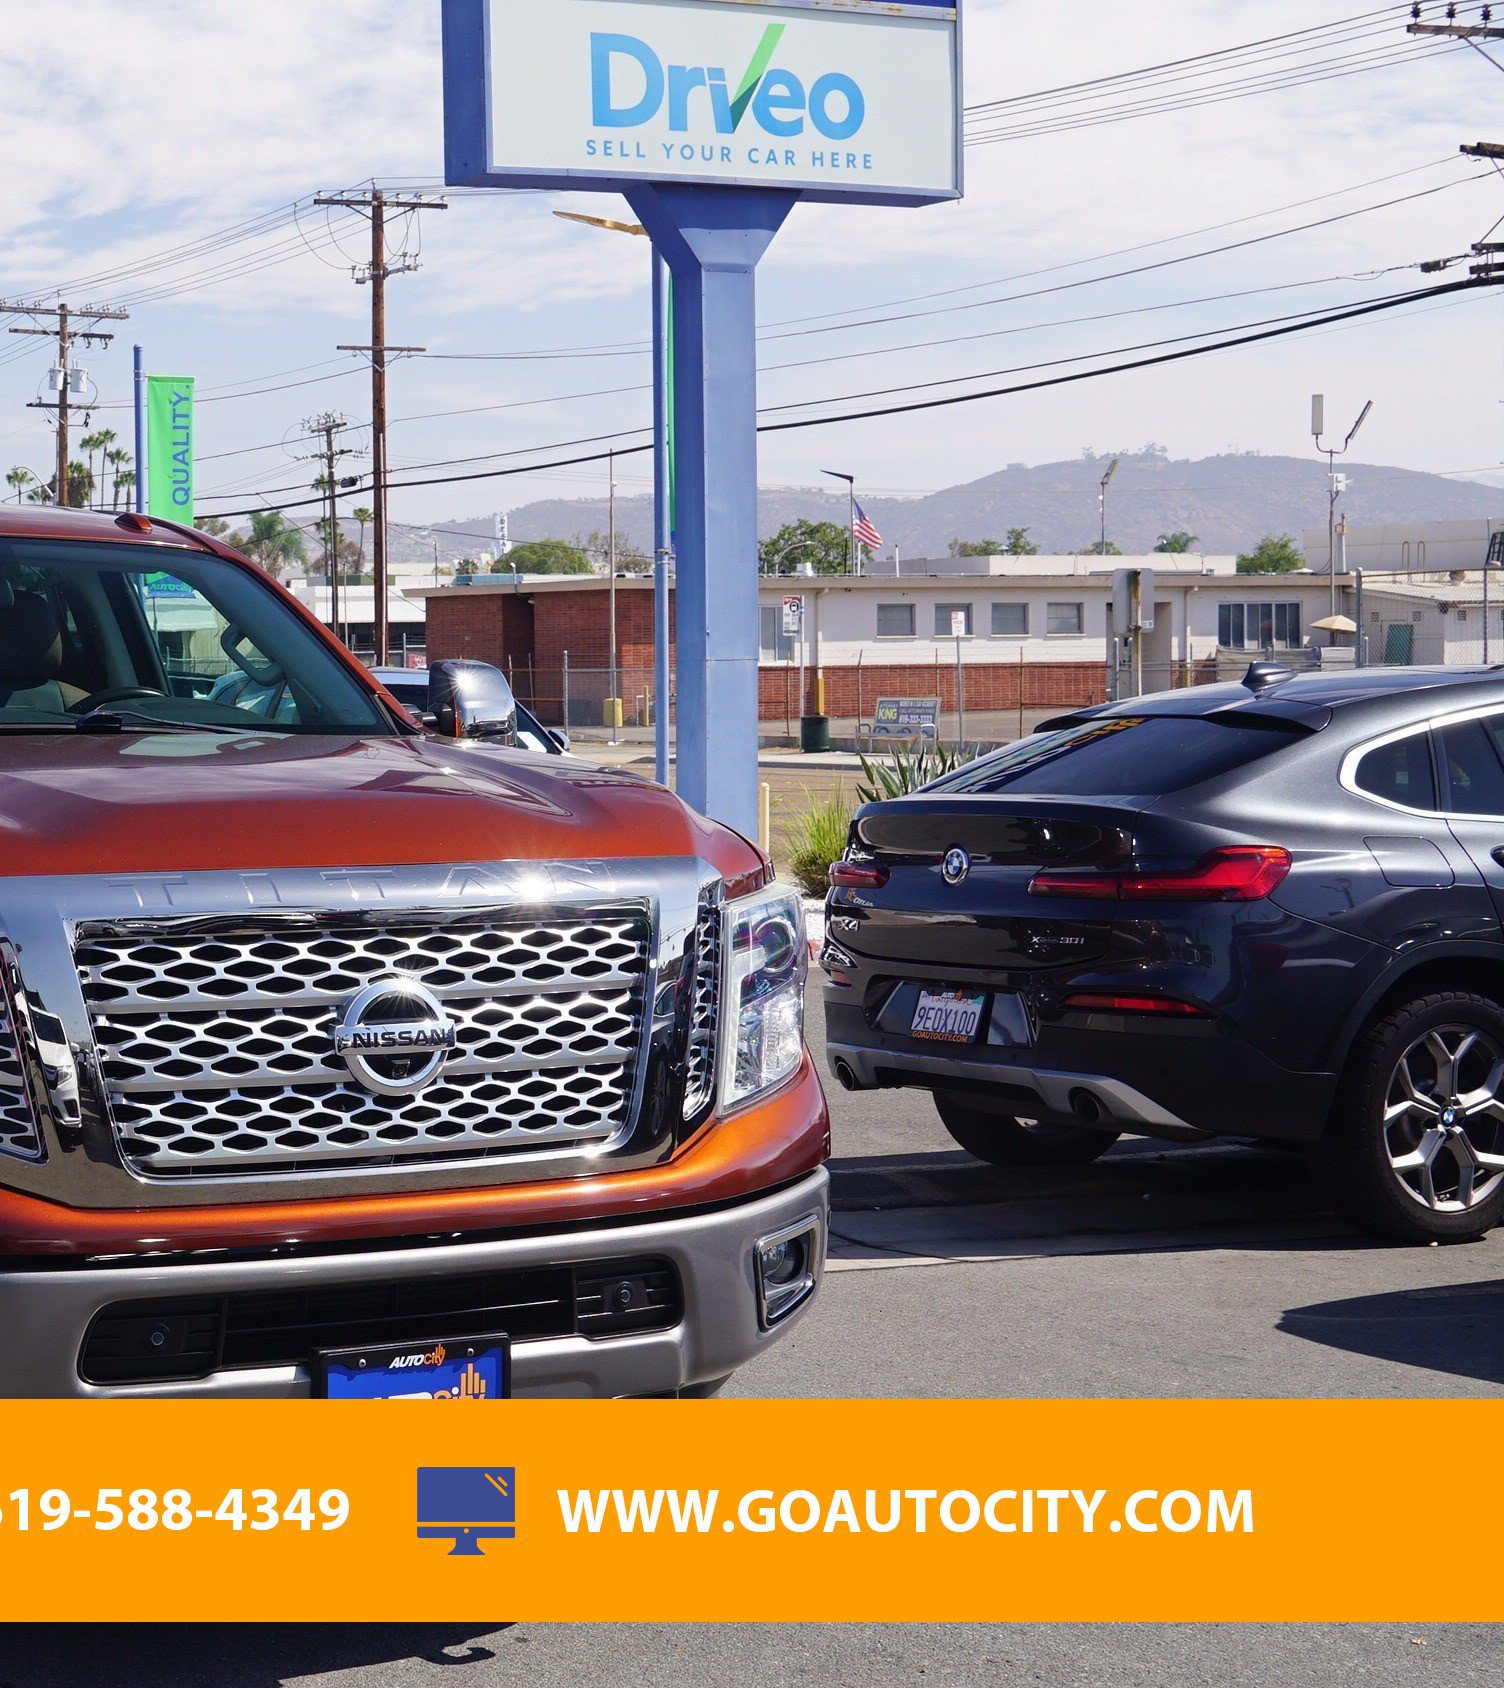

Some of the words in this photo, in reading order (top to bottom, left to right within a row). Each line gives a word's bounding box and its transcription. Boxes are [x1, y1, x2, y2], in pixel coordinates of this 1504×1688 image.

[590, 23, 866, 141] Driveo
[586, 139, 646, 158] SELL
[662, 143, 732, 162] YOUR
[747, 148, 796, 166] CAR
[812, 151, 873, 169] HERE
[171, 384, 191, 506] QUALITY.
[103, 861, 616, 908] TITAN
[351, 1028, 447, 1048] NISSAN
[912, 1031, 968, 1043] GOAUTOCITY.COM
[388, 1343, 446, 1369] AUTOCity
